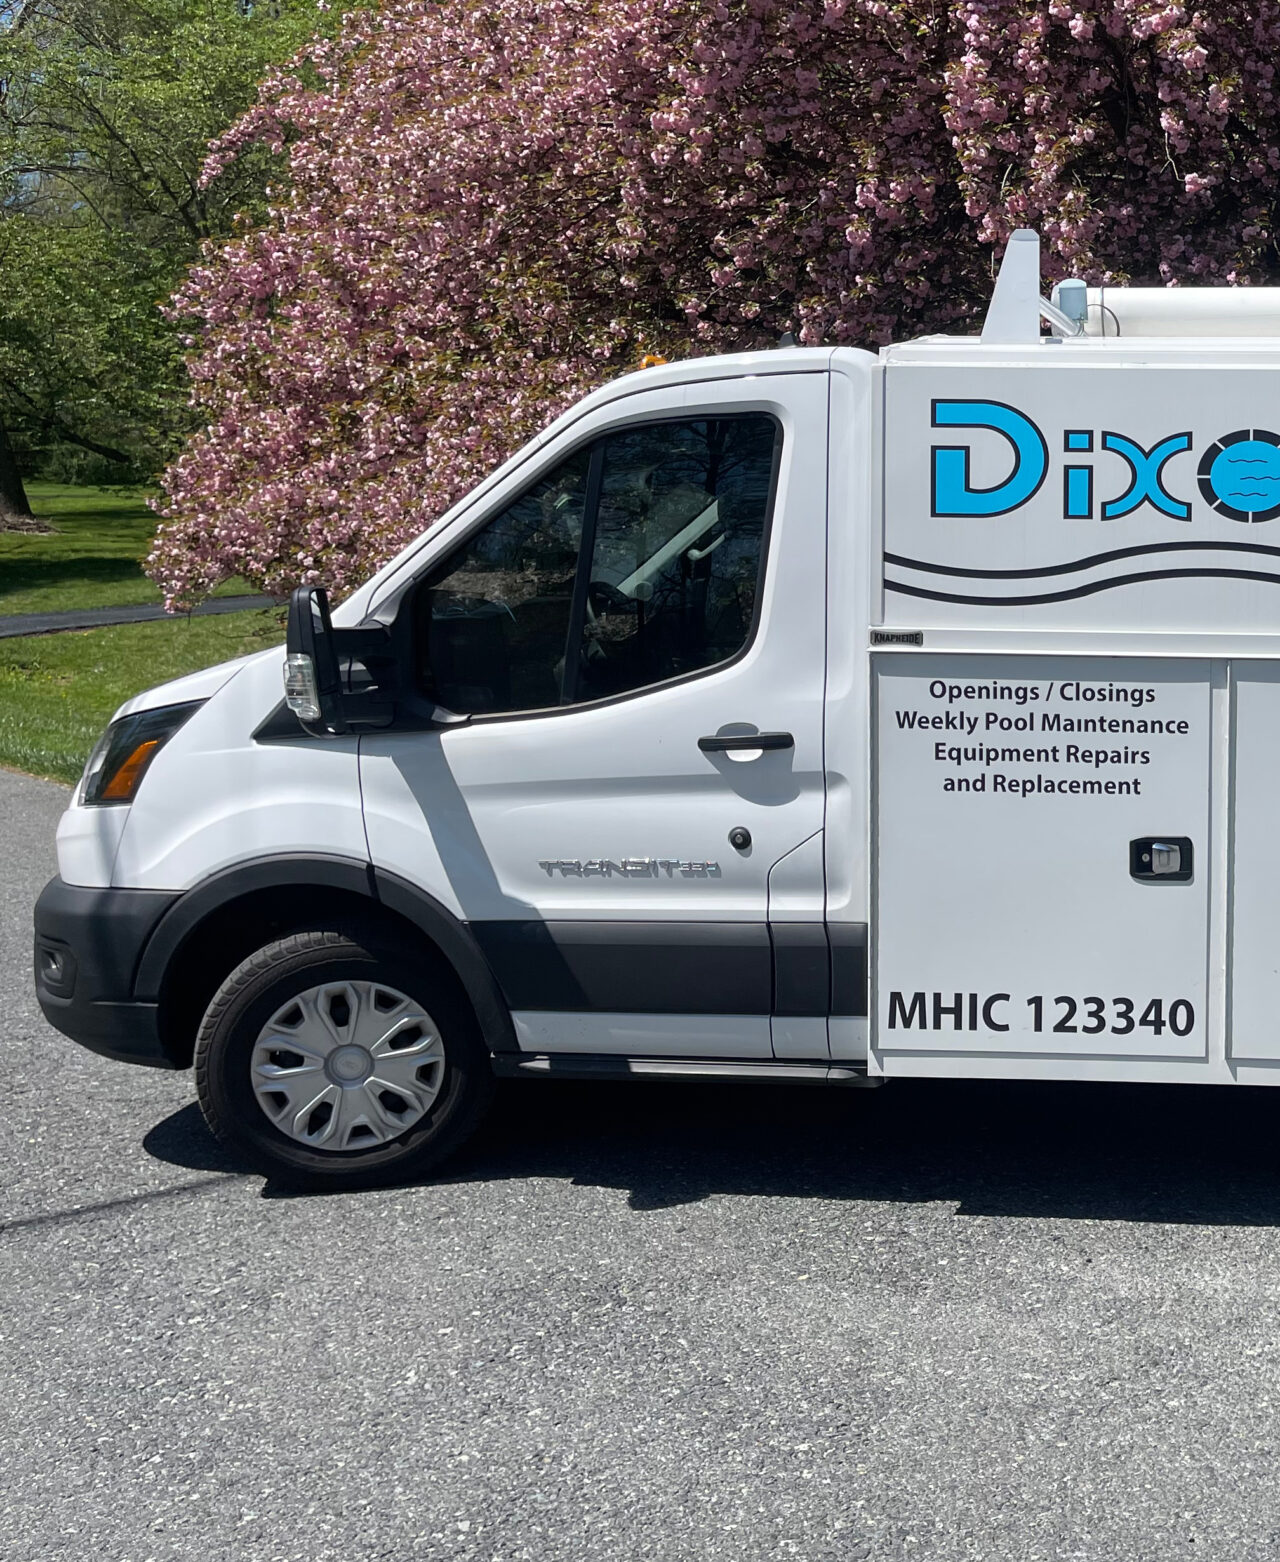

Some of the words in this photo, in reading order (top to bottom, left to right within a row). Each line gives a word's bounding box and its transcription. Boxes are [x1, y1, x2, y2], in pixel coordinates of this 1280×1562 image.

[873, 631, 921, 645] KNAPHEIDE
[929, 681, 1040, 705] Openings
[1059, 683, 1156, 707] Closings
[896, 711, 978, 735] Weekly
[986, 712, 1034, 731] Pool
[1042, 714, 1188, 734] Maintenance
[935, 743, 1059, 766] Equipment
[1067, 745, 1150, 768] Repairs
[944, 773, 985, 792] and
[994, 775, 1140, 797] Replacement
[888, 992, 1010, 1031] MHIC
[1027, 996, 1194, 1036] 123340
